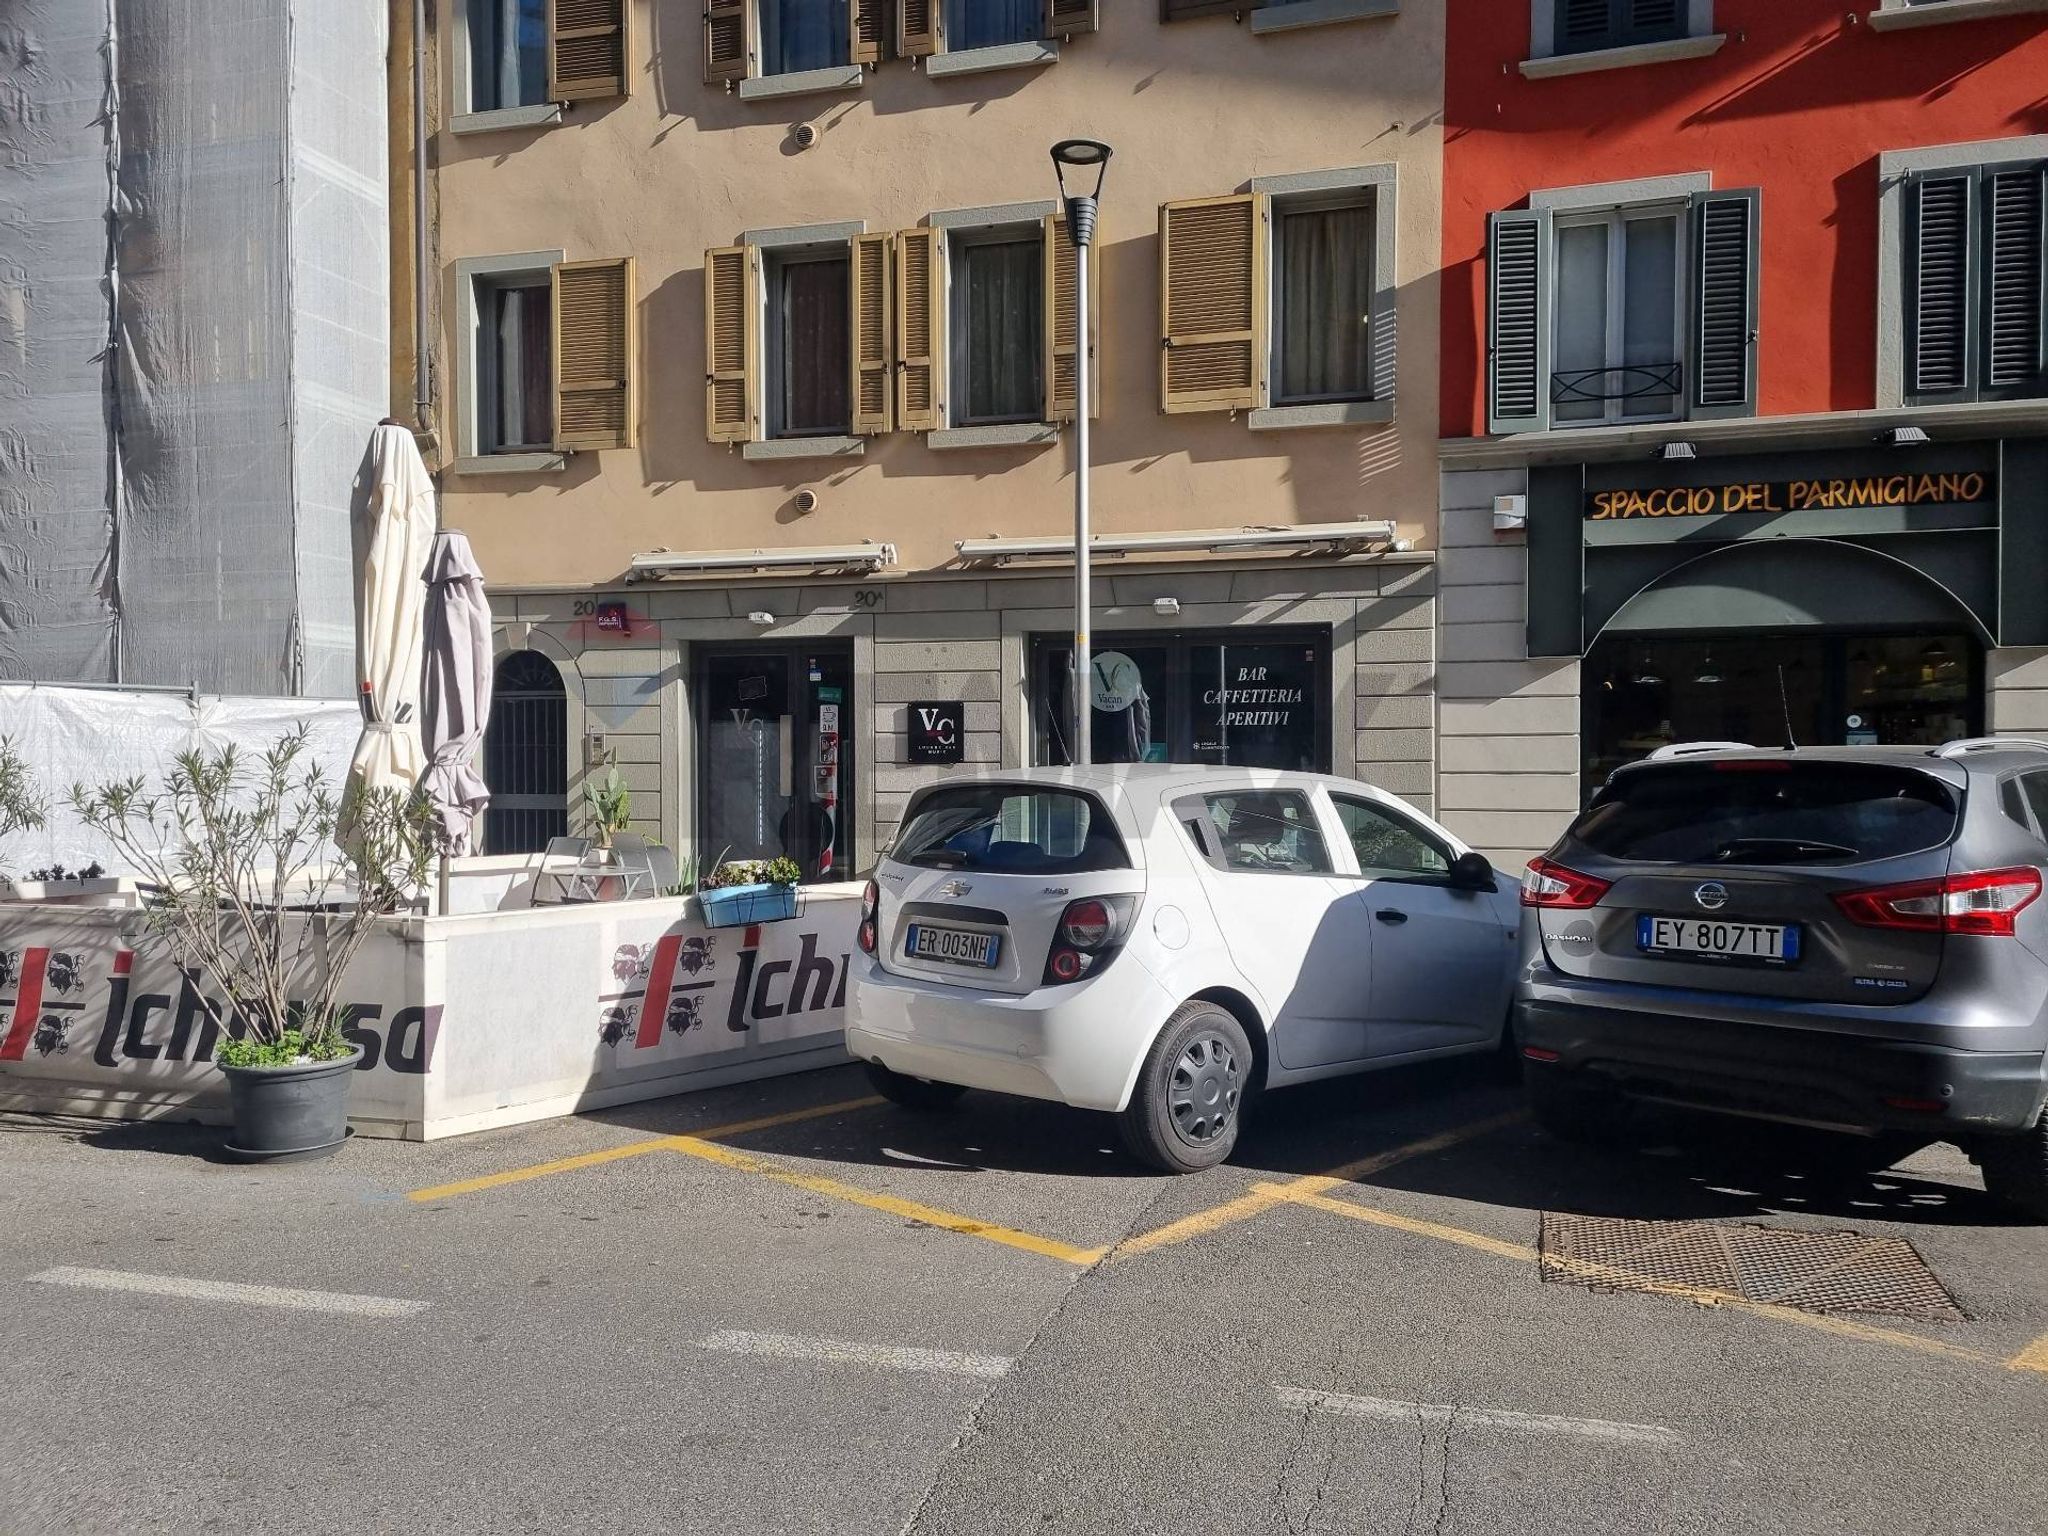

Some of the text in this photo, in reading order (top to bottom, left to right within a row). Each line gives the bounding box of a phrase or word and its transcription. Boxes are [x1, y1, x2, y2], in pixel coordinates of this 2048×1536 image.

[1591, 472, 1984, 520] SPACCIO DEL PARMIGIANO
[573, 600, 595, 616] 20
[1238, 666, 1267, 681] BAR
[1203, 688, 1303, 704] CAFFETTERIA
[917, 708, 955, 745] VC
[1215, 711, 1290, 726] APERITIVI
[918, 928, 938, 953] ER
[941, 933, 990, 961] 003NH
[1655, 920, 1687, 948] EY
[1695, 923, 1781, 955] 807TT
